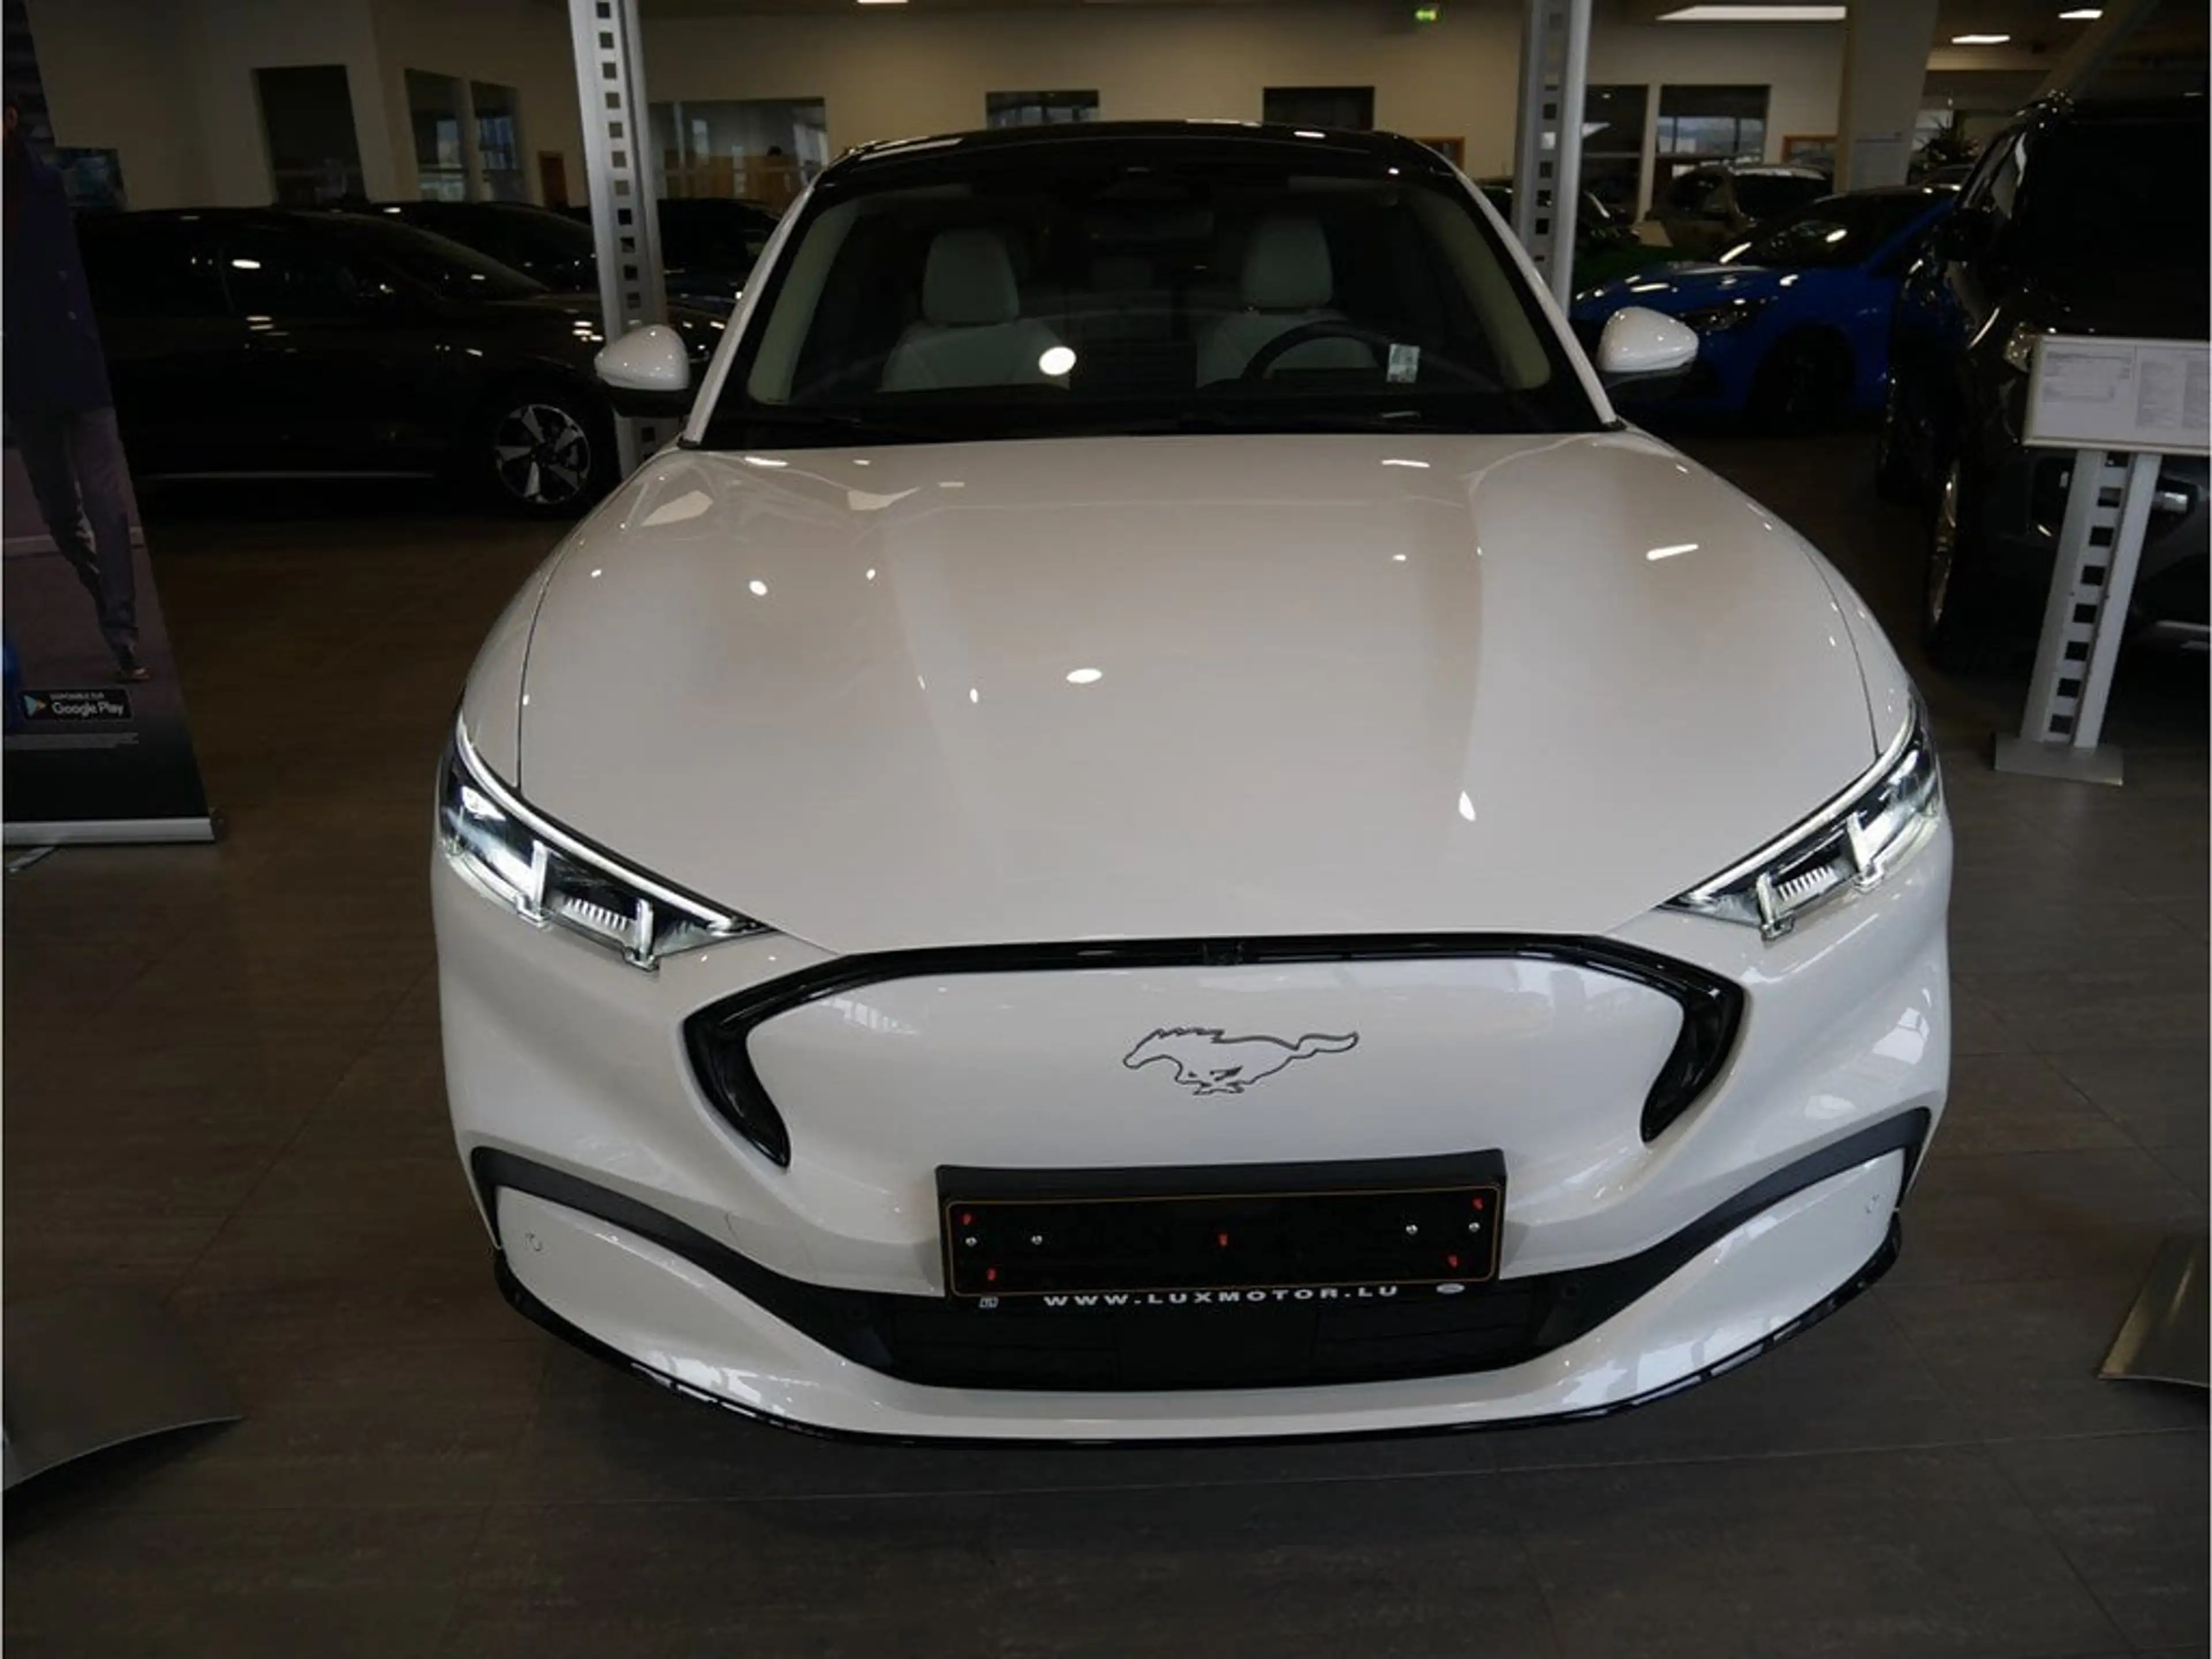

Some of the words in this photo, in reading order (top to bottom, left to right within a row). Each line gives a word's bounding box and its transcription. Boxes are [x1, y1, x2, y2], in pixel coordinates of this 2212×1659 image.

[51, 701, 97, 718] Google
[98, 700, 124, 717] Play
[1043, 1285, 1399, 1306] WWW.LUXMOTOR.LU
